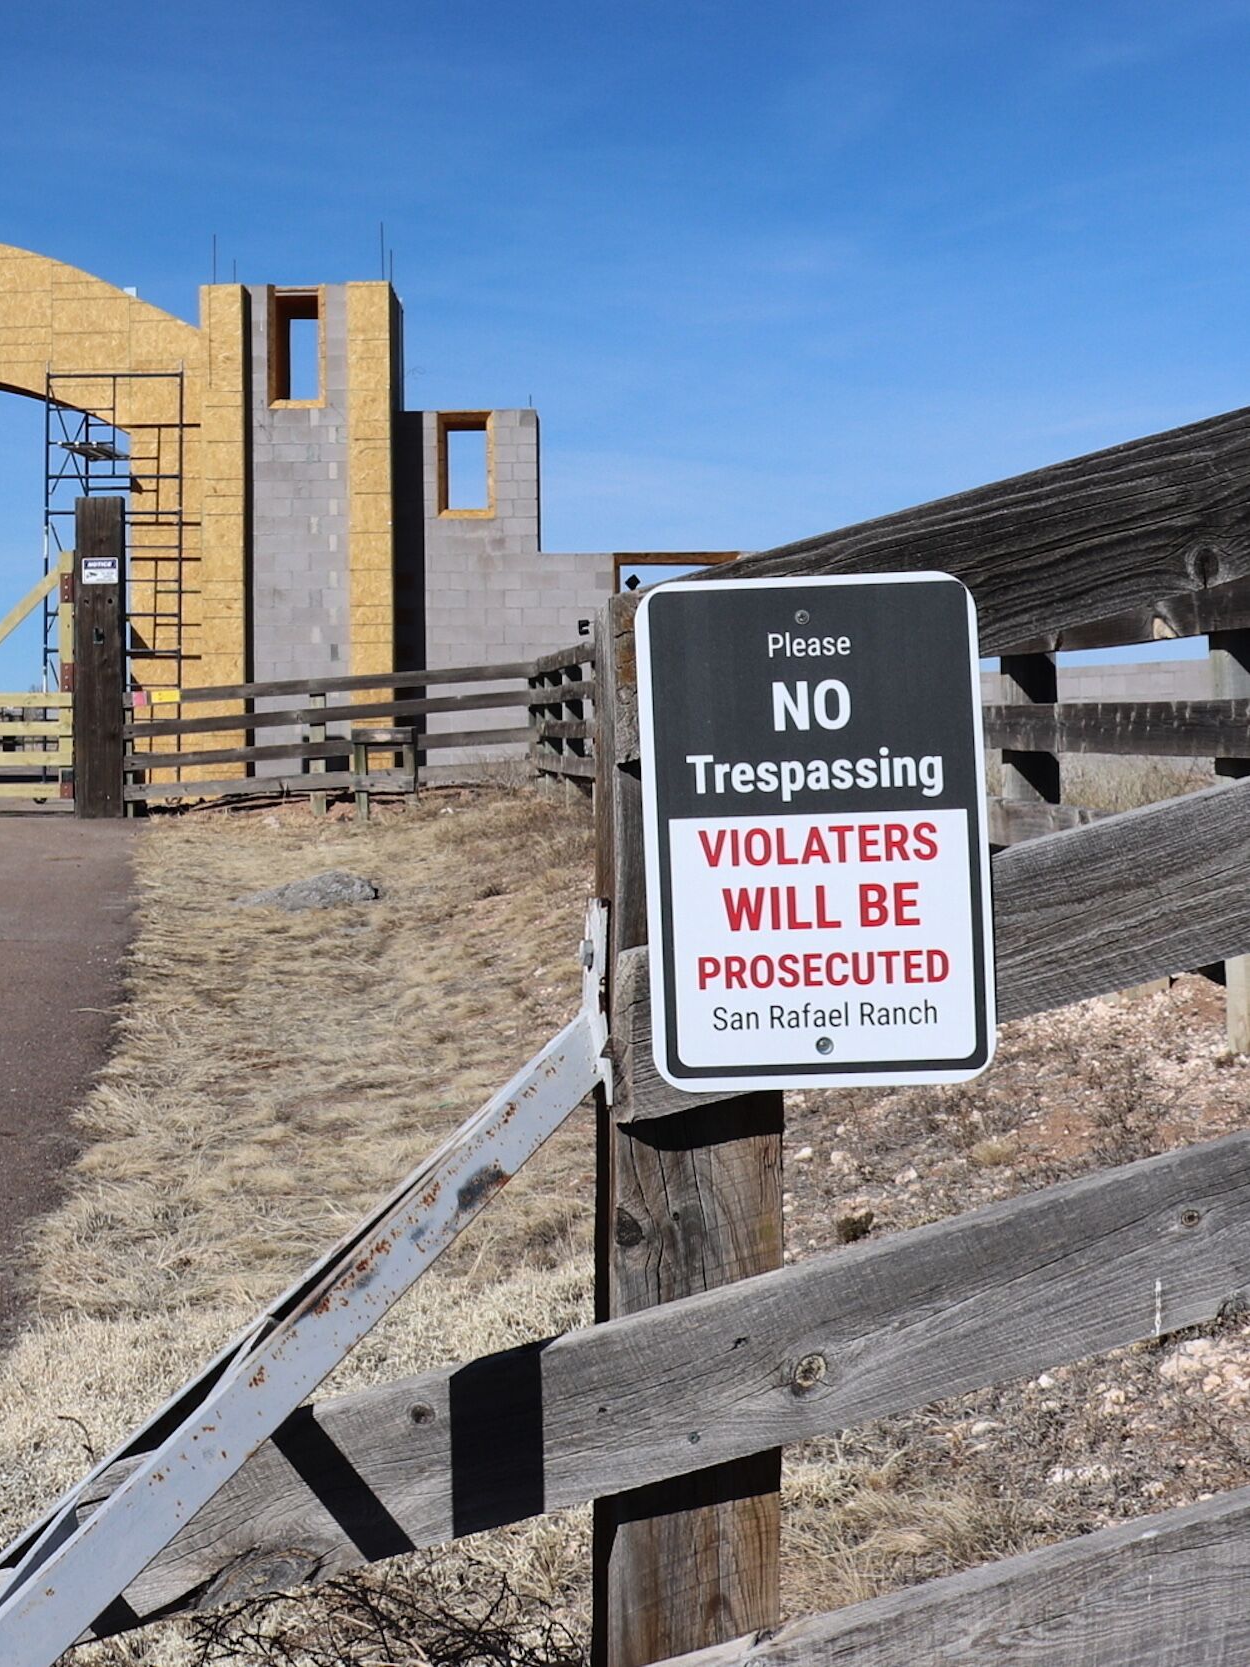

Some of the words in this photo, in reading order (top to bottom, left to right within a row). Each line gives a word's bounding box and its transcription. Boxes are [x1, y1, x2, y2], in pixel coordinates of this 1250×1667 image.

[768, 632, 850, 657] Please
[772, 679, 850, 731] NO
[686, 747, 943, 801] Trespassing
[698, 822, 938, 867] VIOLATERS
[723, 885, 841, 931] WILL
[859, 882, 921, 927] BE
[698, 949, 949, 990] PROSECUTED
[713, 1007, 760, 1031] San
[769, 1002, 849, 1030] Rafael
[859, 999, 938, 1027] Ranch
